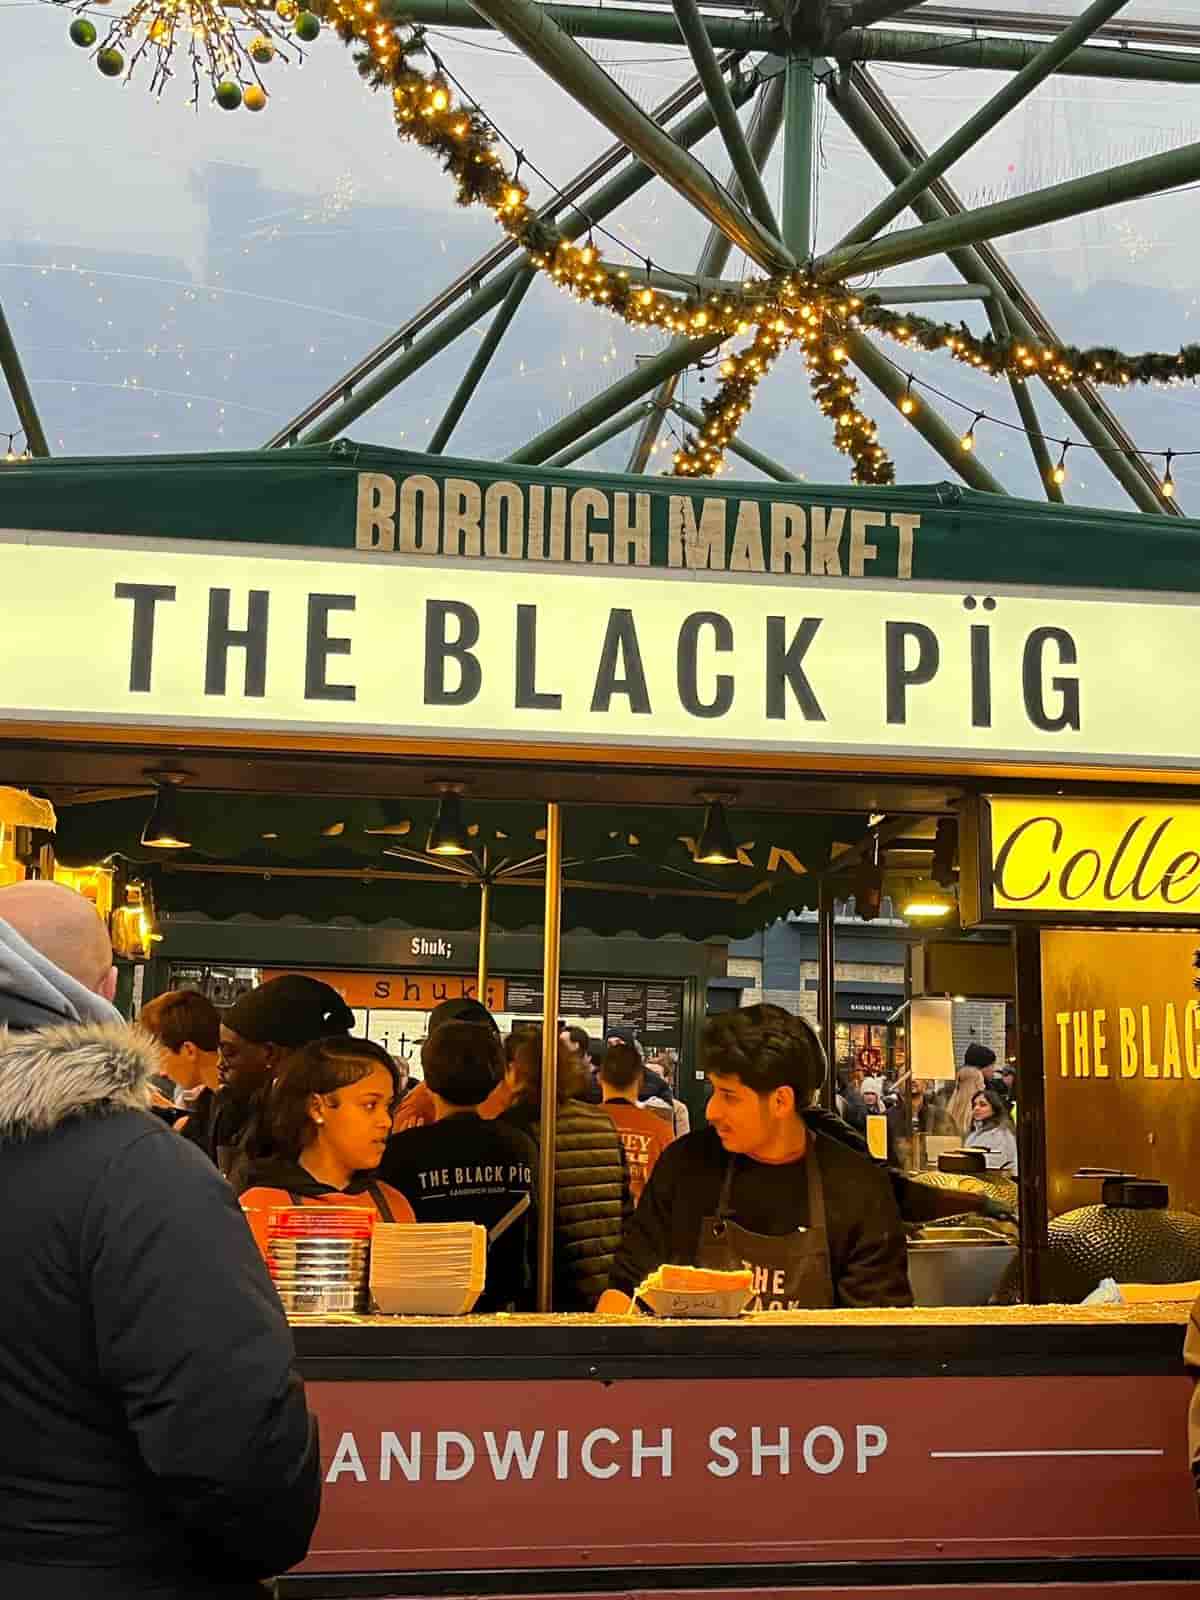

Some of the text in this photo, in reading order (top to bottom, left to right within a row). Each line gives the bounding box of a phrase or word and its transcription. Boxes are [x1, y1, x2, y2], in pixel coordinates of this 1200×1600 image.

[354, 471, 921, 579] BOROUGH MARKET
[115, 582, 1081, 732] THE BLACK PÏG
[993, 816, 1200, 904] Colle
[411, 937, 452, 959] Shuk;
[1056, 1009, 1109, 1079] THE
[418, 1169, 449, 1189] THE
[455, 1165, 503, 1184] BLACK
[325, 1424, 888, 1482] ANDWICH SHOP
